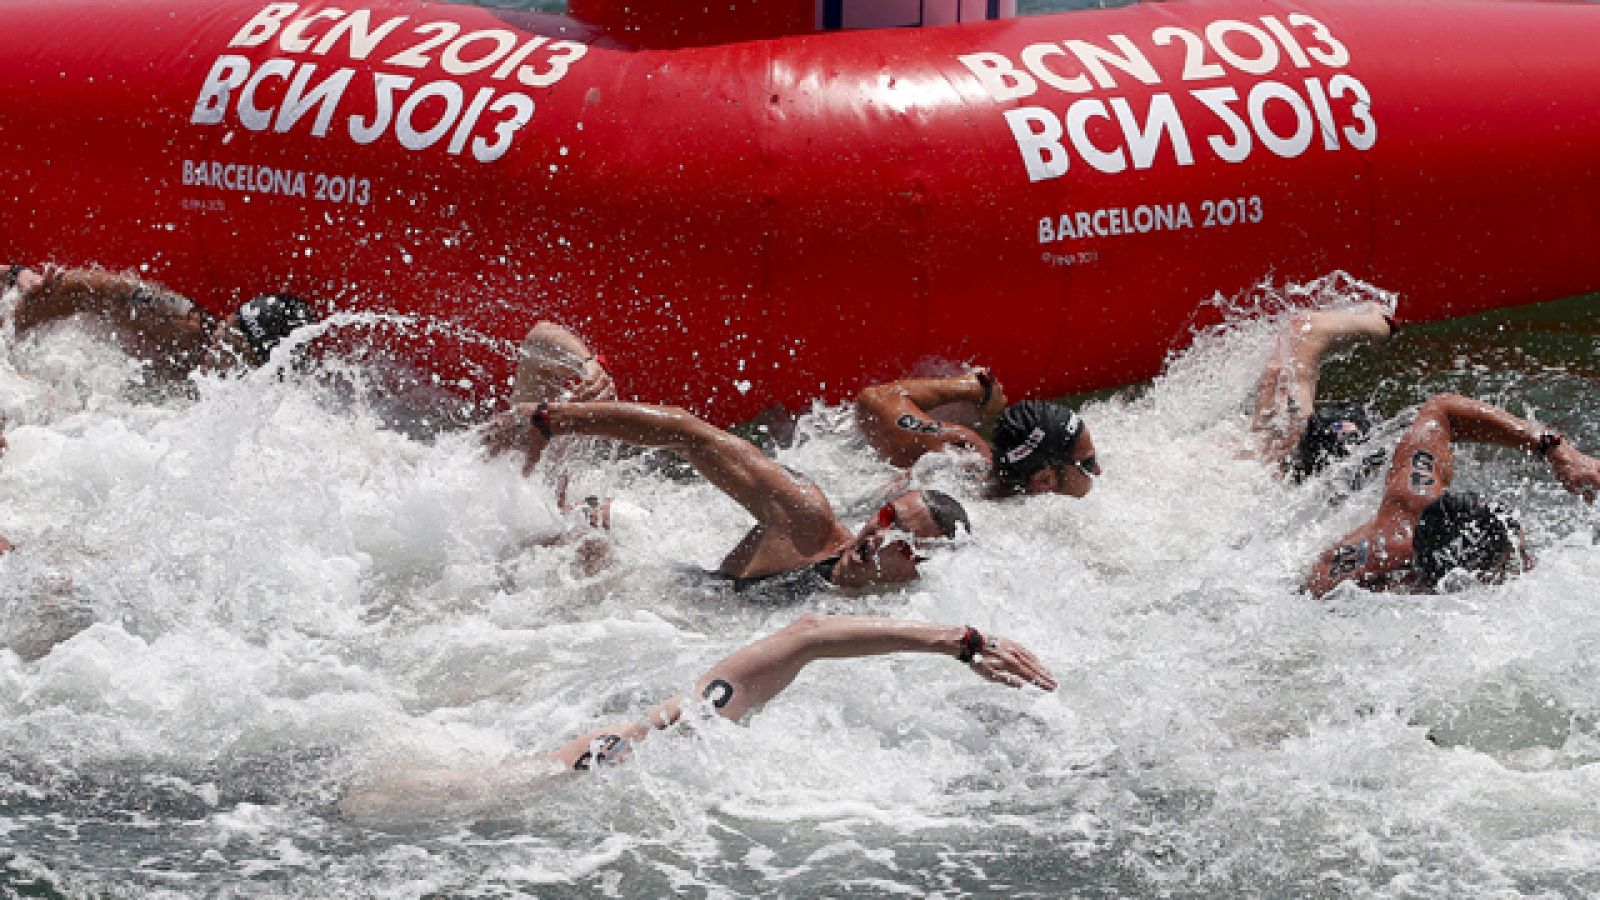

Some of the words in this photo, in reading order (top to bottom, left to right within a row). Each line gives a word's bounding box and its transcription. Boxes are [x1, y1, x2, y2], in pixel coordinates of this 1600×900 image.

[227, 2, 410, 60] BCN
[384, 21, 588, 88] 2013
[957, 33, 1162, 103] BCN
[1151, 11, 1351, 81] 2013
[181, 159, 308, 198] BARCELONA
[313, 171, 372, 206] 2013
[1038, 203, 1193, 243] BARCELONA
[1201, 195, 1264, 229] 2013
